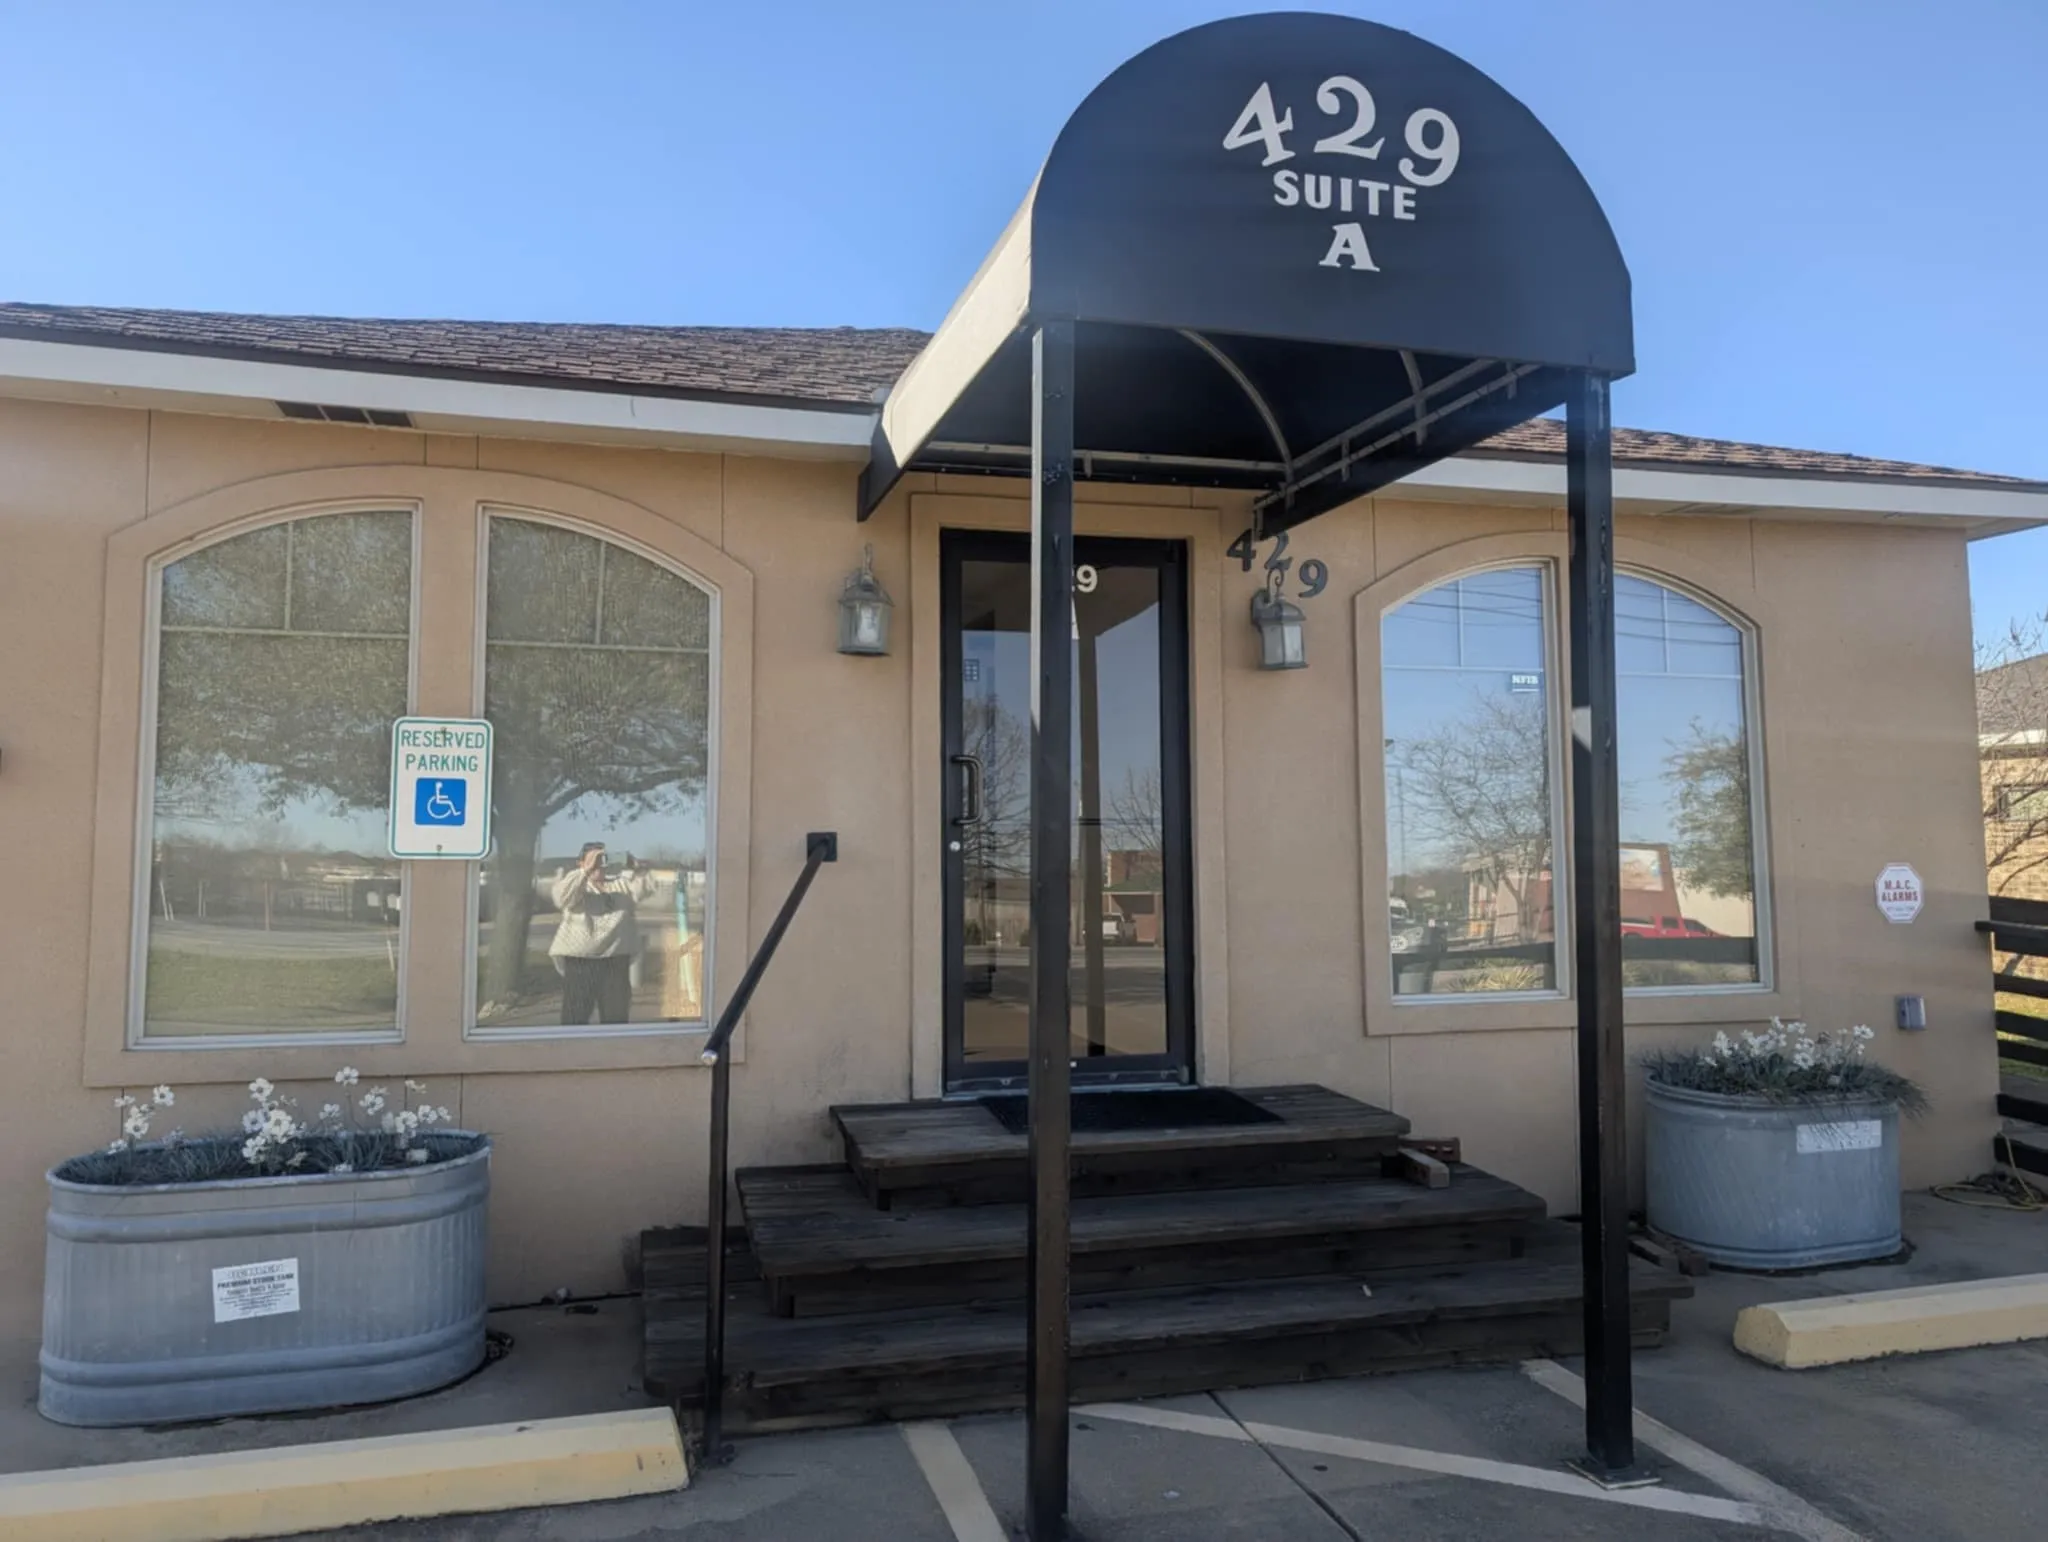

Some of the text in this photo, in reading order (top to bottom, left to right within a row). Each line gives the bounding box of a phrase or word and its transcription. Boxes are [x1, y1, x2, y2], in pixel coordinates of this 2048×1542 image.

[1222, 75, 1460, 187] 429
[1273, 169, 1417, 220] SUITE
[1318, 222, 1380, 272] A
[1226, 528, 1328, 598] 429
[401, 730, 485, 749] RESERVED
[405, 753, 478, 772] PARKING
[1881, 890, 1919, 902] ALARMS
